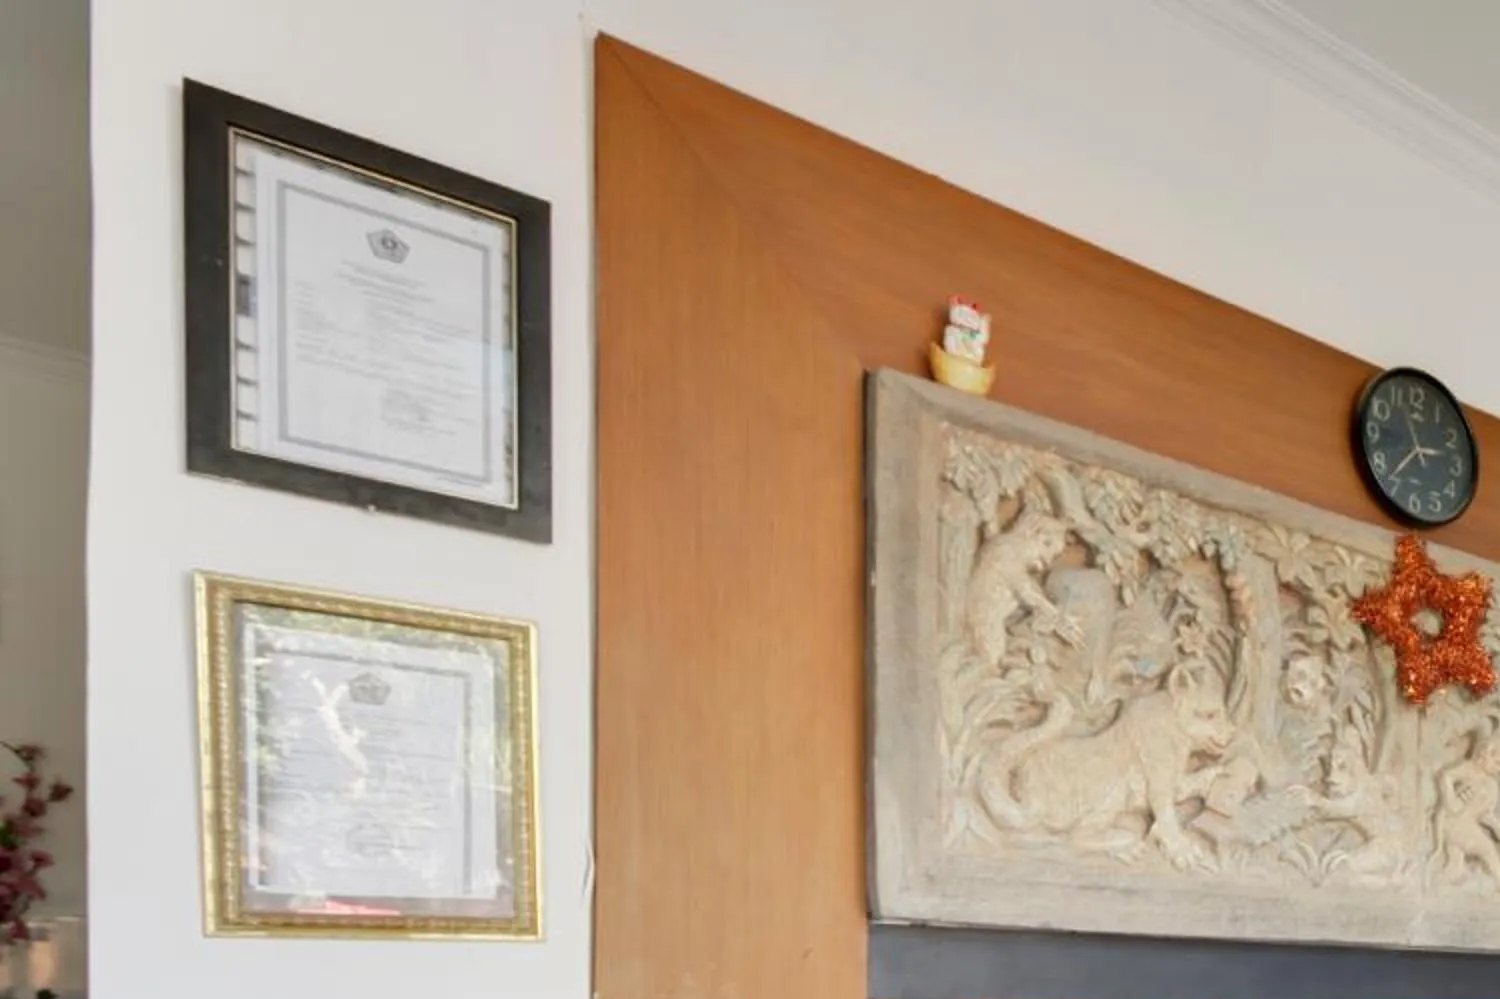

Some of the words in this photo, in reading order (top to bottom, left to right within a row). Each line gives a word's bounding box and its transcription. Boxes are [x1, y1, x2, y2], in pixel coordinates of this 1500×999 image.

[1391, 385, 1403, 408] 11
[1409, 384, 1426, 411] 12
[1434, 400, 1441, 424] 1
[1366, 421, 1380, 444] 9
[1445, 427, 1458, 449] 2
[1373, 451, 1387, 476] 8
[1450, 454, 1463, 477] 3
[1388, 475, 1402, 498] 7
[1443, 479, 1456, 499] 4
[1409, 492, 1422, 514] 6
[1428, 489, 1443, 513] 5
